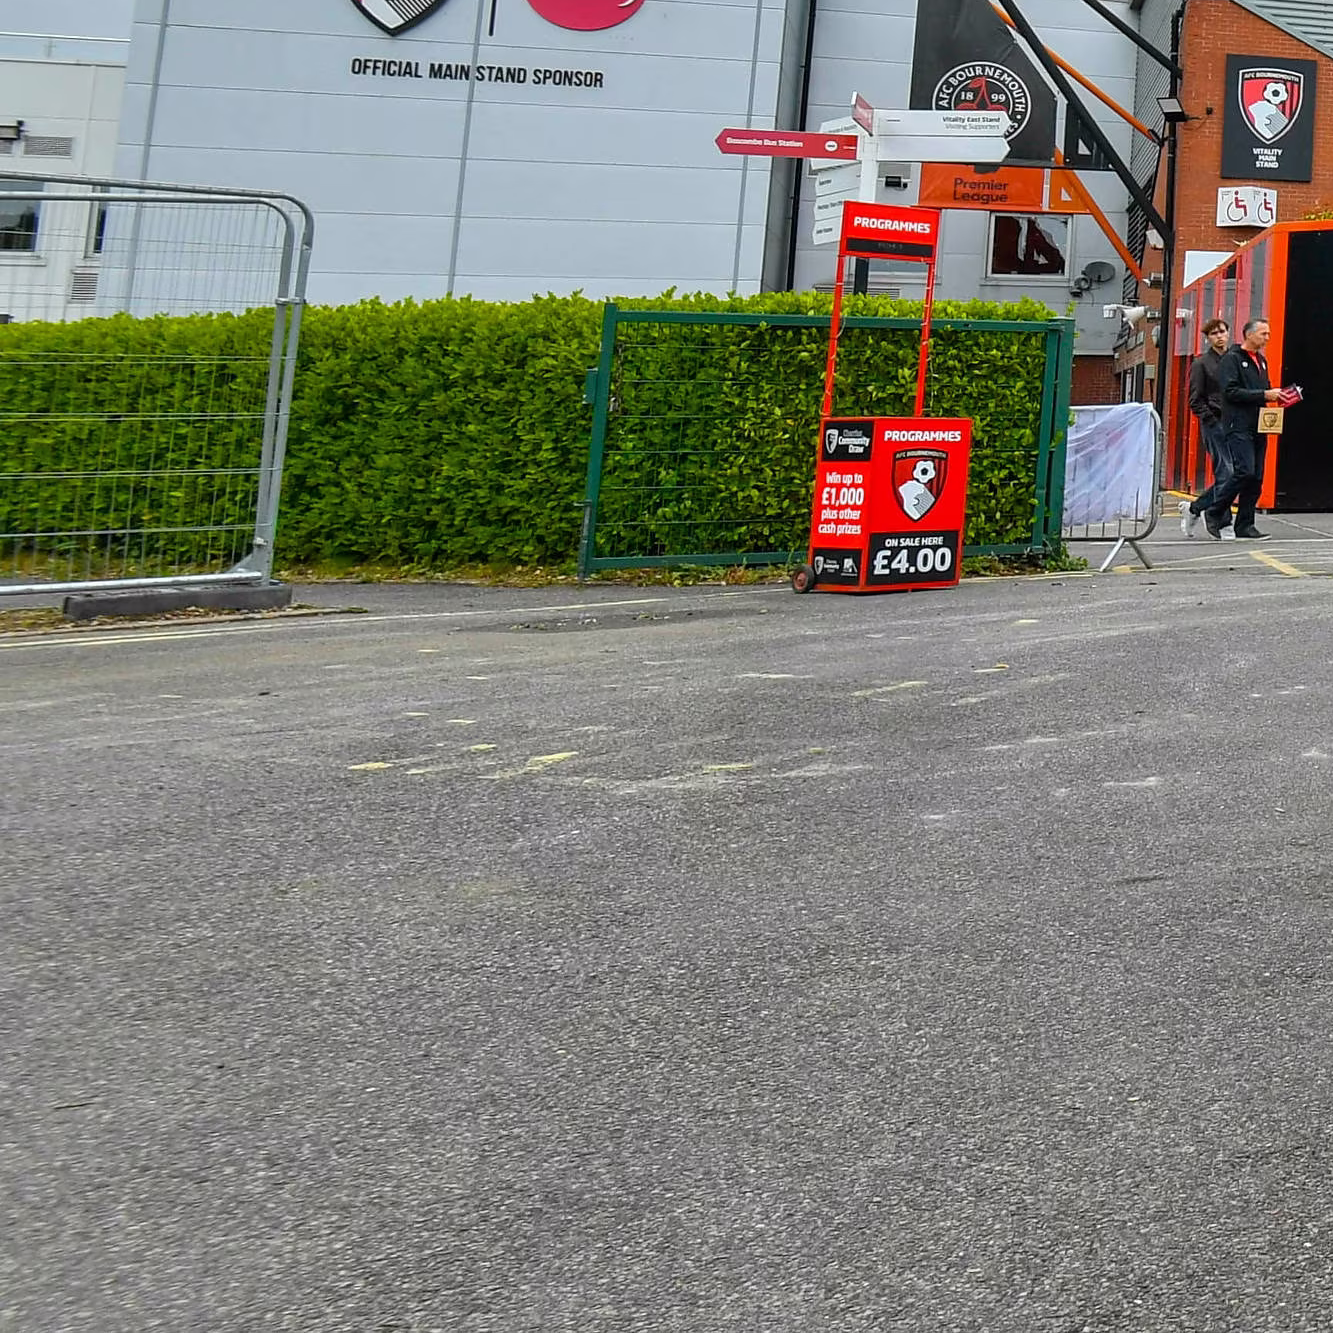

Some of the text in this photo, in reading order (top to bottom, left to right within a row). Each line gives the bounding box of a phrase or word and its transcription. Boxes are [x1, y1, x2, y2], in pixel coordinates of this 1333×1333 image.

[351, 58, 604, 88] OFFICIAL MAIN STAND SPONSOR
[938, 66, 1026, 112] AFC BOURNEMOUTH
[960, 91, 1006, 102] 18 99
[954, 178, 1008, 191] Premier
[953, 189, 1008, 204] League
[854, 217, 931, 233] PROGRAMMES
[884, 431, 961, 442] PROGRAMMES
[826, 472, 862, 486] Win up to
[822, 487, 864, 507] £1,000
[821, 509, 860, 521] plus other
[818, 523, 836, 534] cash
[884, 537, 944, 547] ON SALE HERE
[873, 547, 952, 575] £4.00
